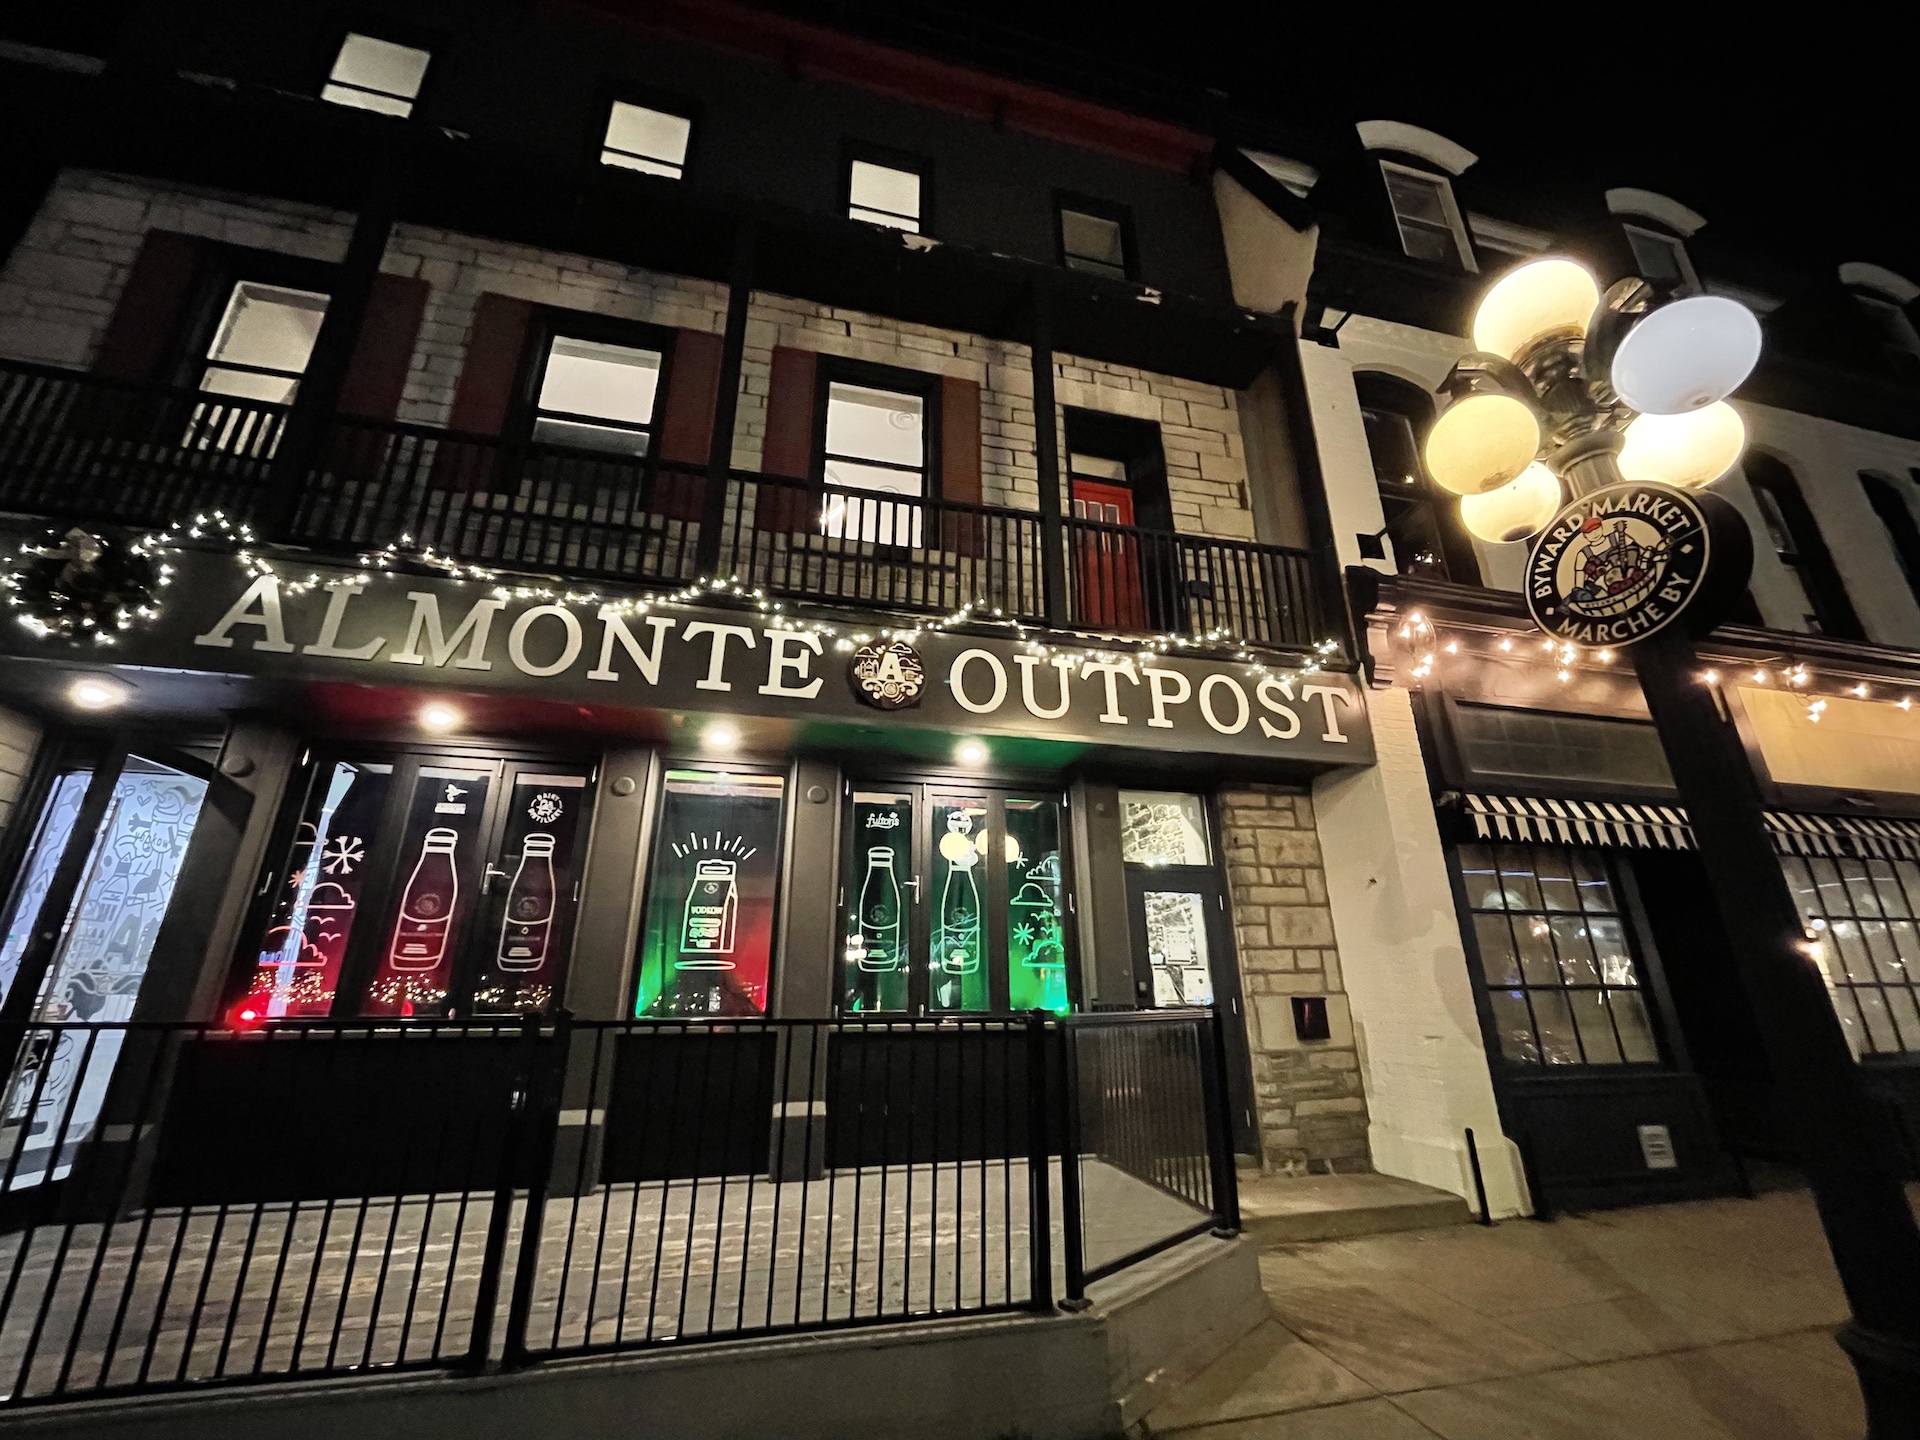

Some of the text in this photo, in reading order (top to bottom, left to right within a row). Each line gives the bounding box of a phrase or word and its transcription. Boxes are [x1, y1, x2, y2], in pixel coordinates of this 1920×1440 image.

[1534, 493, 1691, 599] BYWARD MARKET
[194, 574, 1351, 743] ALMONTE OUTPOST
[1557, 602, 1666, 642] MARCHÉ
[1659, 572, 1692, 603] BY
